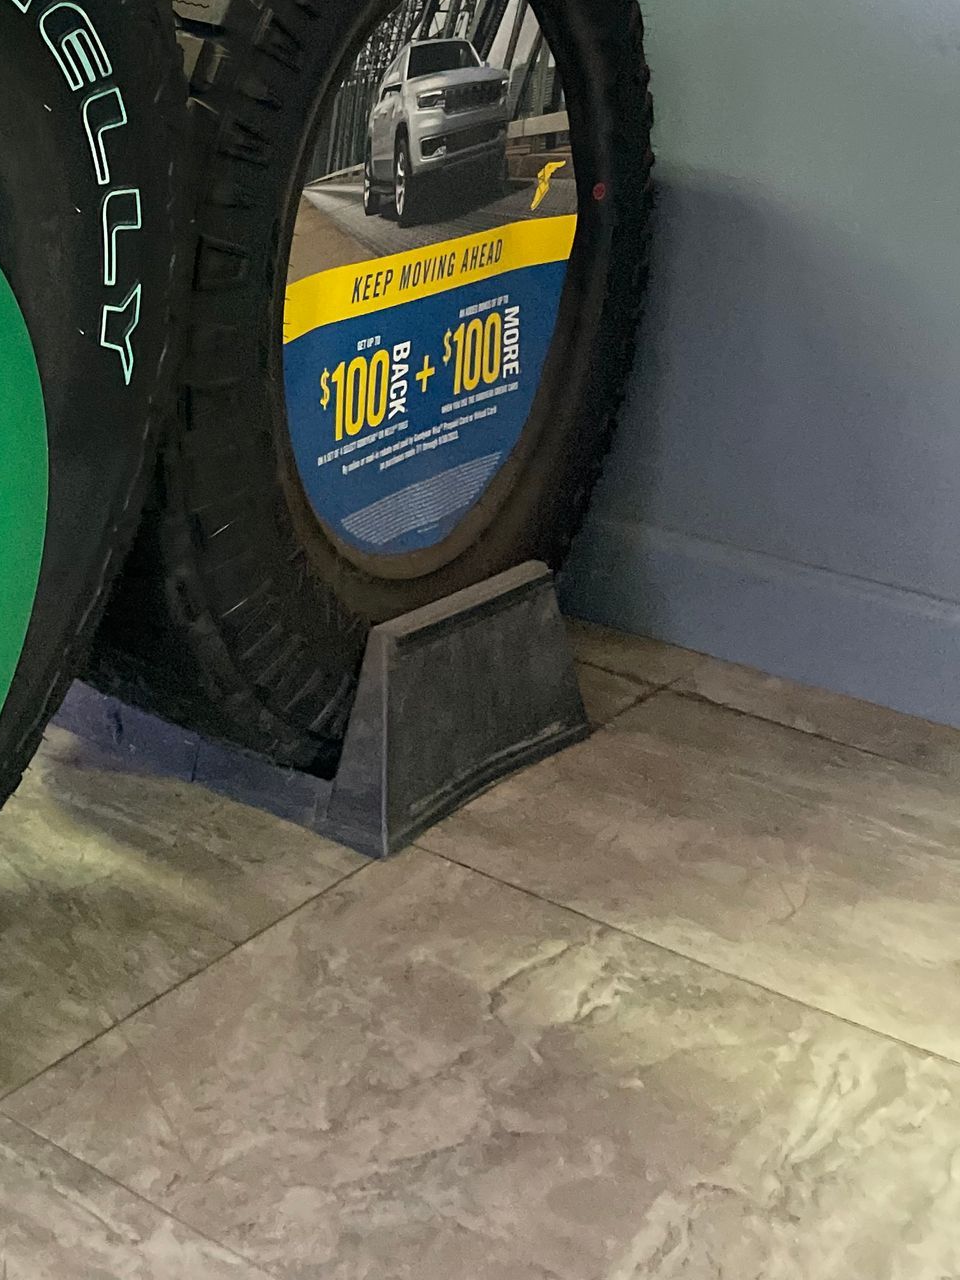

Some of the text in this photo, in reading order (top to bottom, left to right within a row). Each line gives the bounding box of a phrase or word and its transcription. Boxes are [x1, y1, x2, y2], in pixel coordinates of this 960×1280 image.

[351, 238, 503, 304] KEEP MOVING AHEAD
[320, 348, 390, 442] $100
[442, 312, 502, 396] $100
